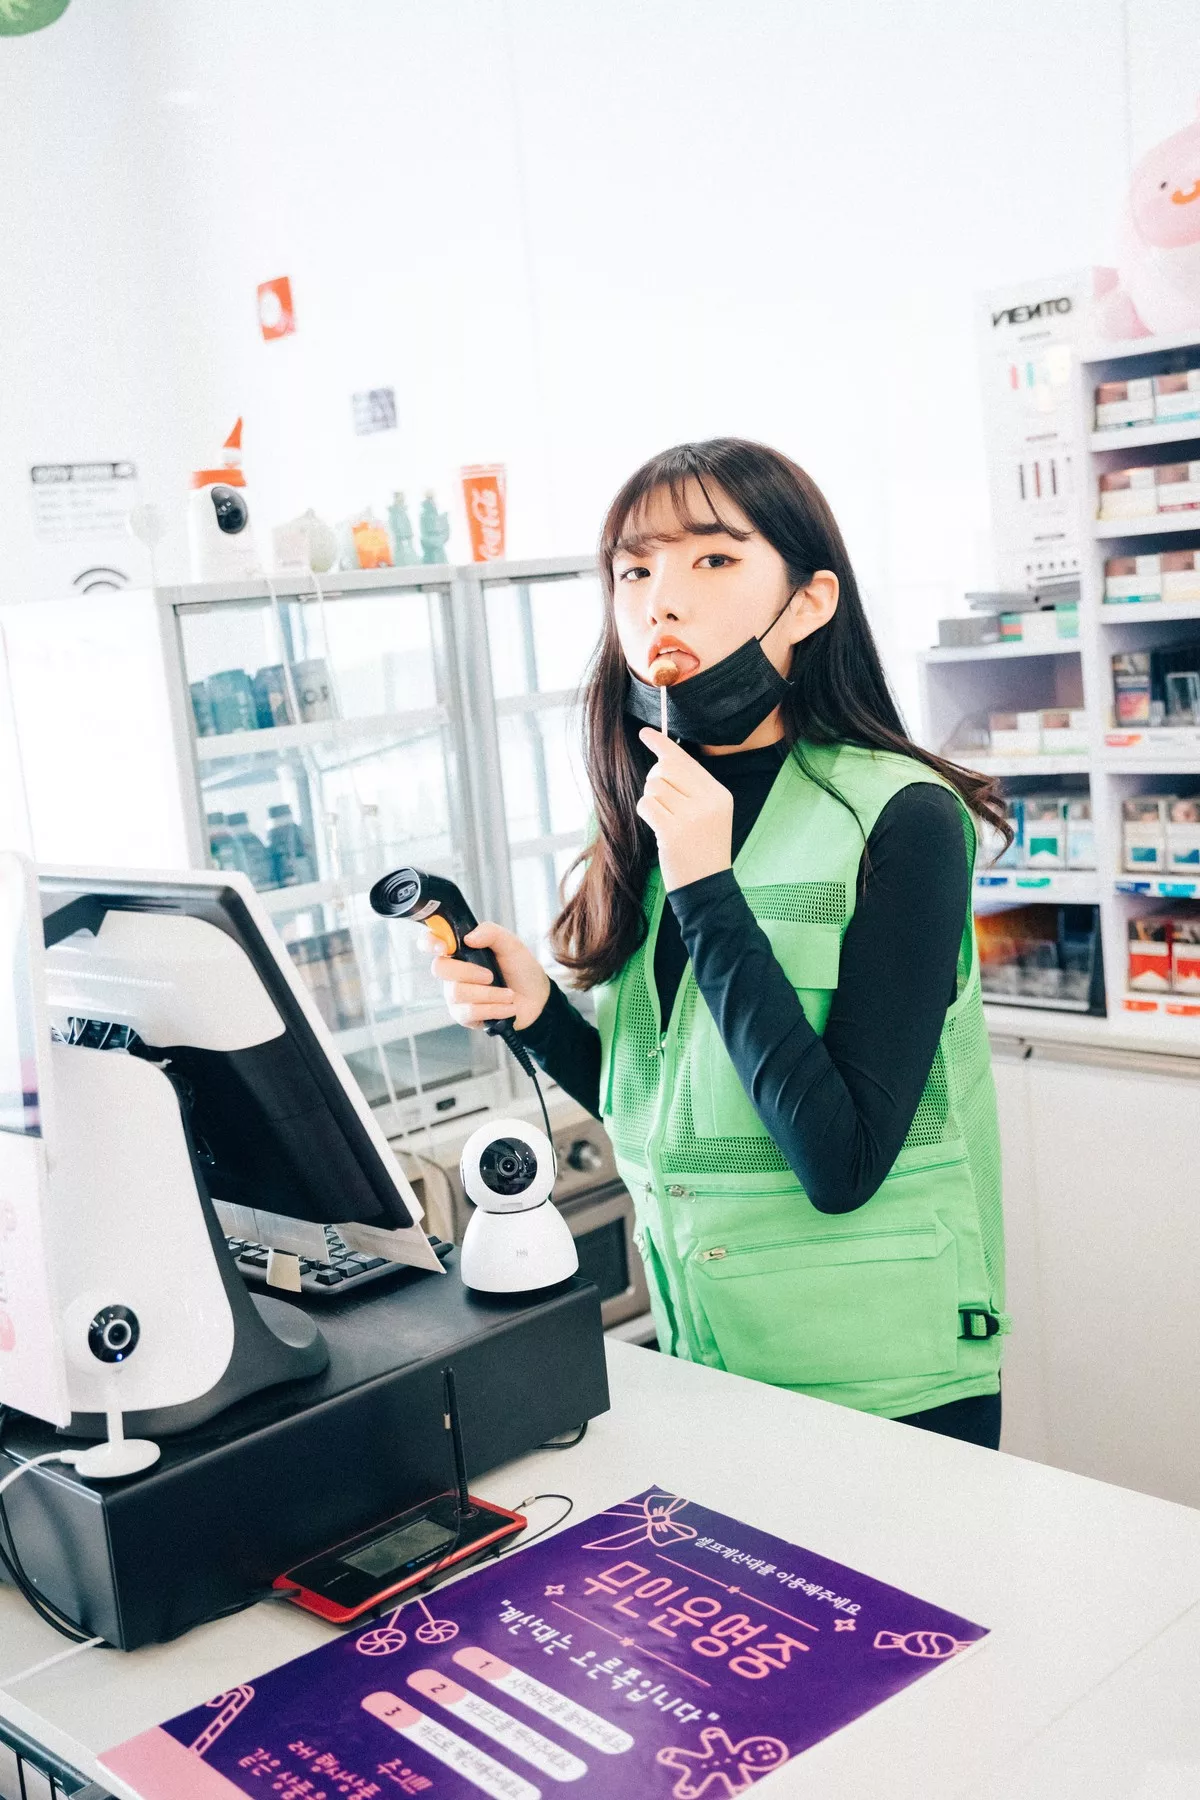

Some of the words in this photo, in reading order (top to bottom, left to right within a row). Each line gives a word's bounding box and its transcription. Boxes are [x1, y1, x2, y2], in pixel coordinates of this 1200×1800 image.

[694, 1535, 776, 1577] 셀프계산대를
[775, 1571, 863, 1617] 이용해주세요
[583, 1560, 811, 1680] 무인운영중
[478, 1660, 493, 1670] 1
[430, 1683, 447, 1694] 2
[384, 1706, 402, 1717] 3
[238, 1747, 281, 1777] 같은
[310, 1752, 382, 1800] 행사상품
